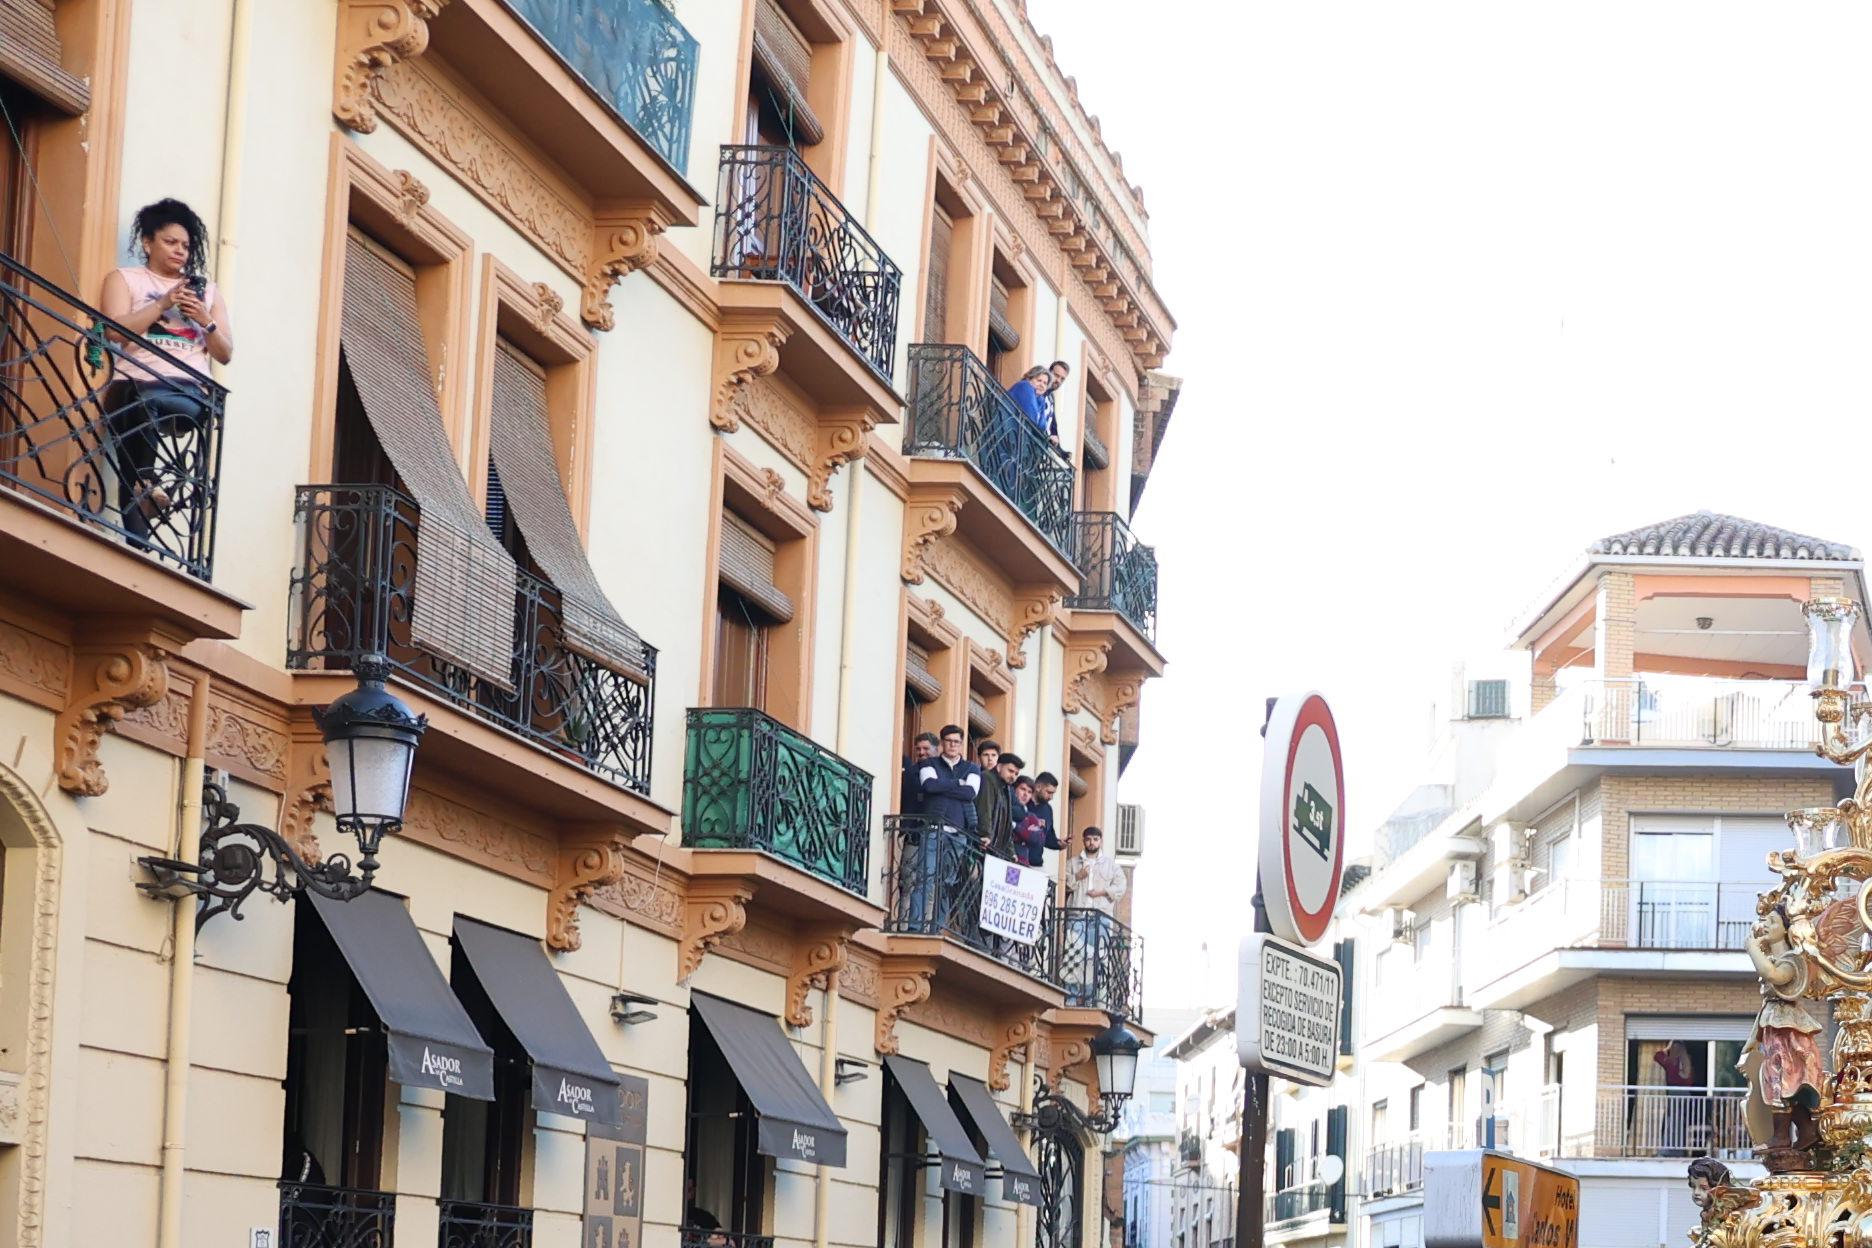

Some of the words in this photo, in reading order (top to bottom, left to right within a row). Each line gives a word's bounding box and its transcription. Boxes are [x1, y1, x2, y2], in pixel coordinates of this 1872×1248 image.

[982, 907, 1035, 938] ALQUILER
[1000, 895, 1017, 915] 285
[1019, 902, 1038, 921] 379
[1299, 964, 1334, 996] 70.471/11
[1264, 979, 1293, 1009] EXCEPTO
[1294, 990, 1323, 1019] SERVICIO
[1325, 1001, 1334, 1022] DE
[1263, 1004, 1296, 1034] RECOGIDA
[1297, 1015, 1306, 1037] DE
[1307, 1019, 1332, 1046] BASURA
[1264, 1029, 1275, 1051] DE
[1276, 1033, 1297, 1058] 23:00
[1298, 1040, 1303, 1060] A
[1305, 1043, 1320, 1065] 5:00
